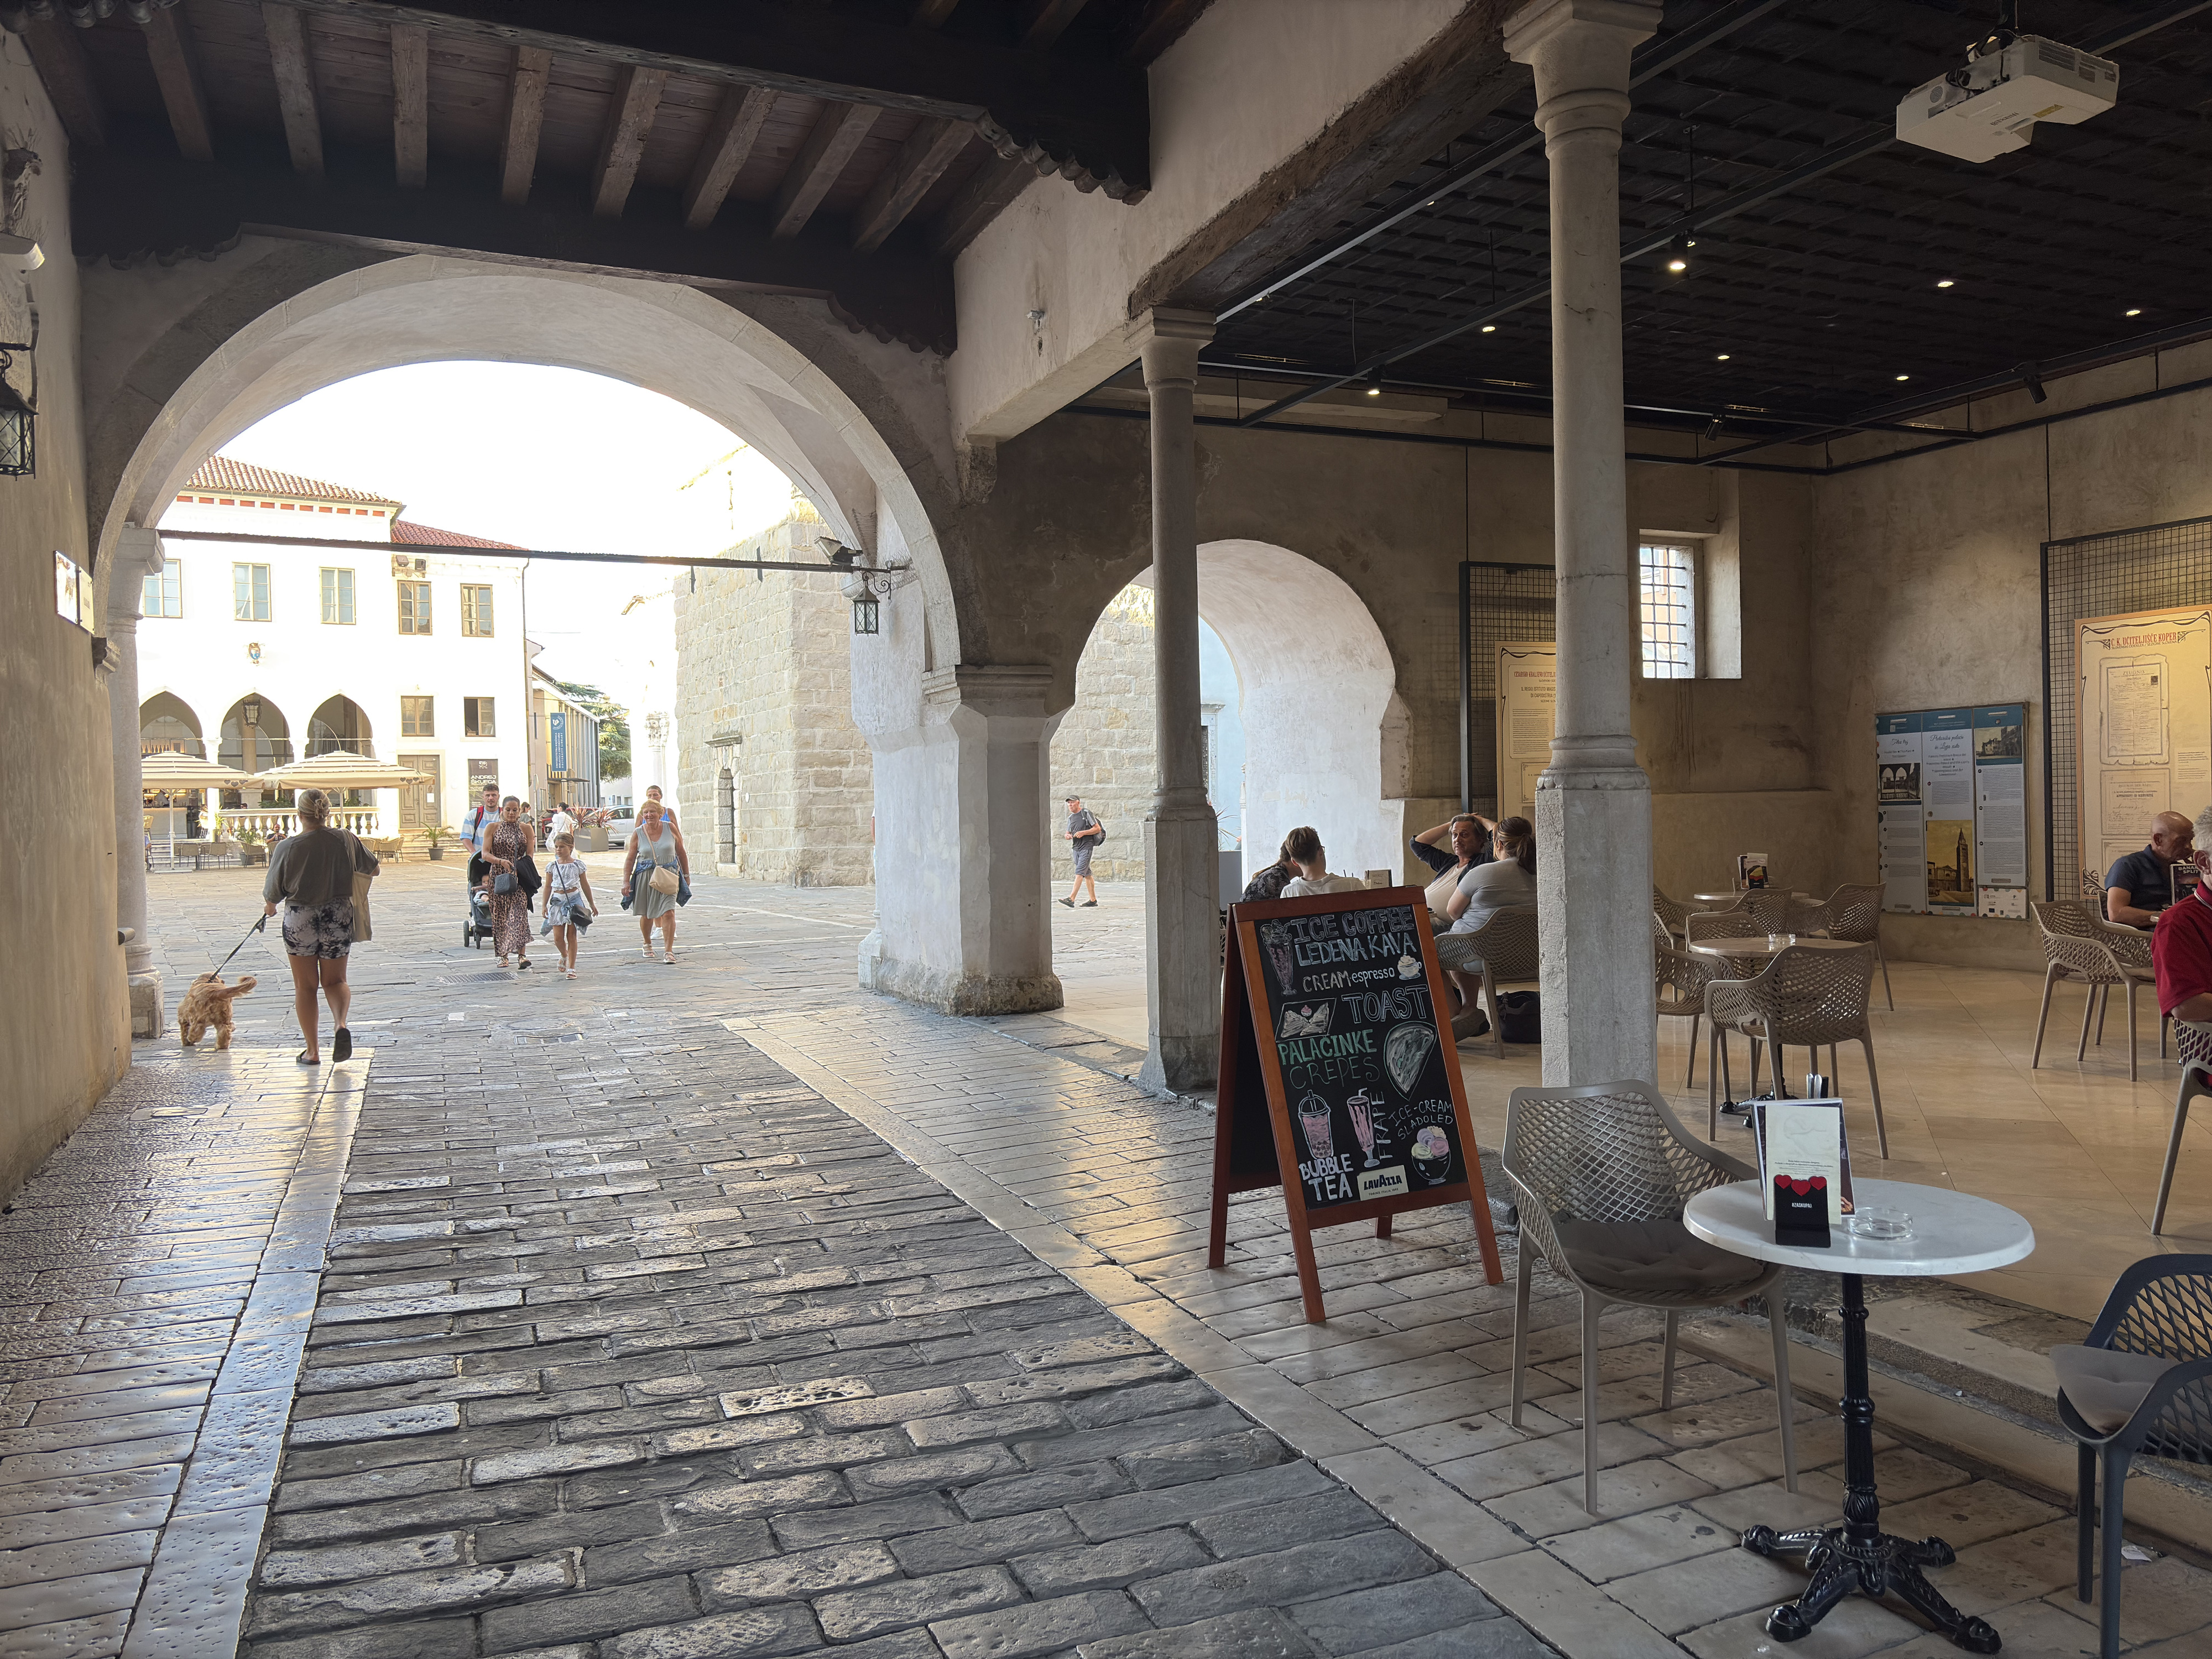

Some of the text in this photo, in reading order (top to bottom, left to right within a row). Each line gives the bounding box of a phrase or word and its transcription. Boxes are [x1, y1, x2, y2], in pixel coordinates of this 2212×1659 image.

[2158, 632, 2177, 641] KOPER
[1291, 906, 1415, 944] ICE COFFEE
[1295, 932, 1417, 966] LEDENA KAVA
[1341, 984, 1428, 1024] TOAST
[1290, 1056, 1380, 1089] CREPES
[1370, 1092, 1392, 1160] FRAPE
[1388, 1099, 1452, 1126] ICE-CREAM
[1398, 1115, 1453, 1140] SLADOLED
[1298, 1154, 1354, 1180] BUBBLE
[1308, 1173, 1353, 1201] TEA
[1364, 1175, 1402, 1190] LAVAZZA
